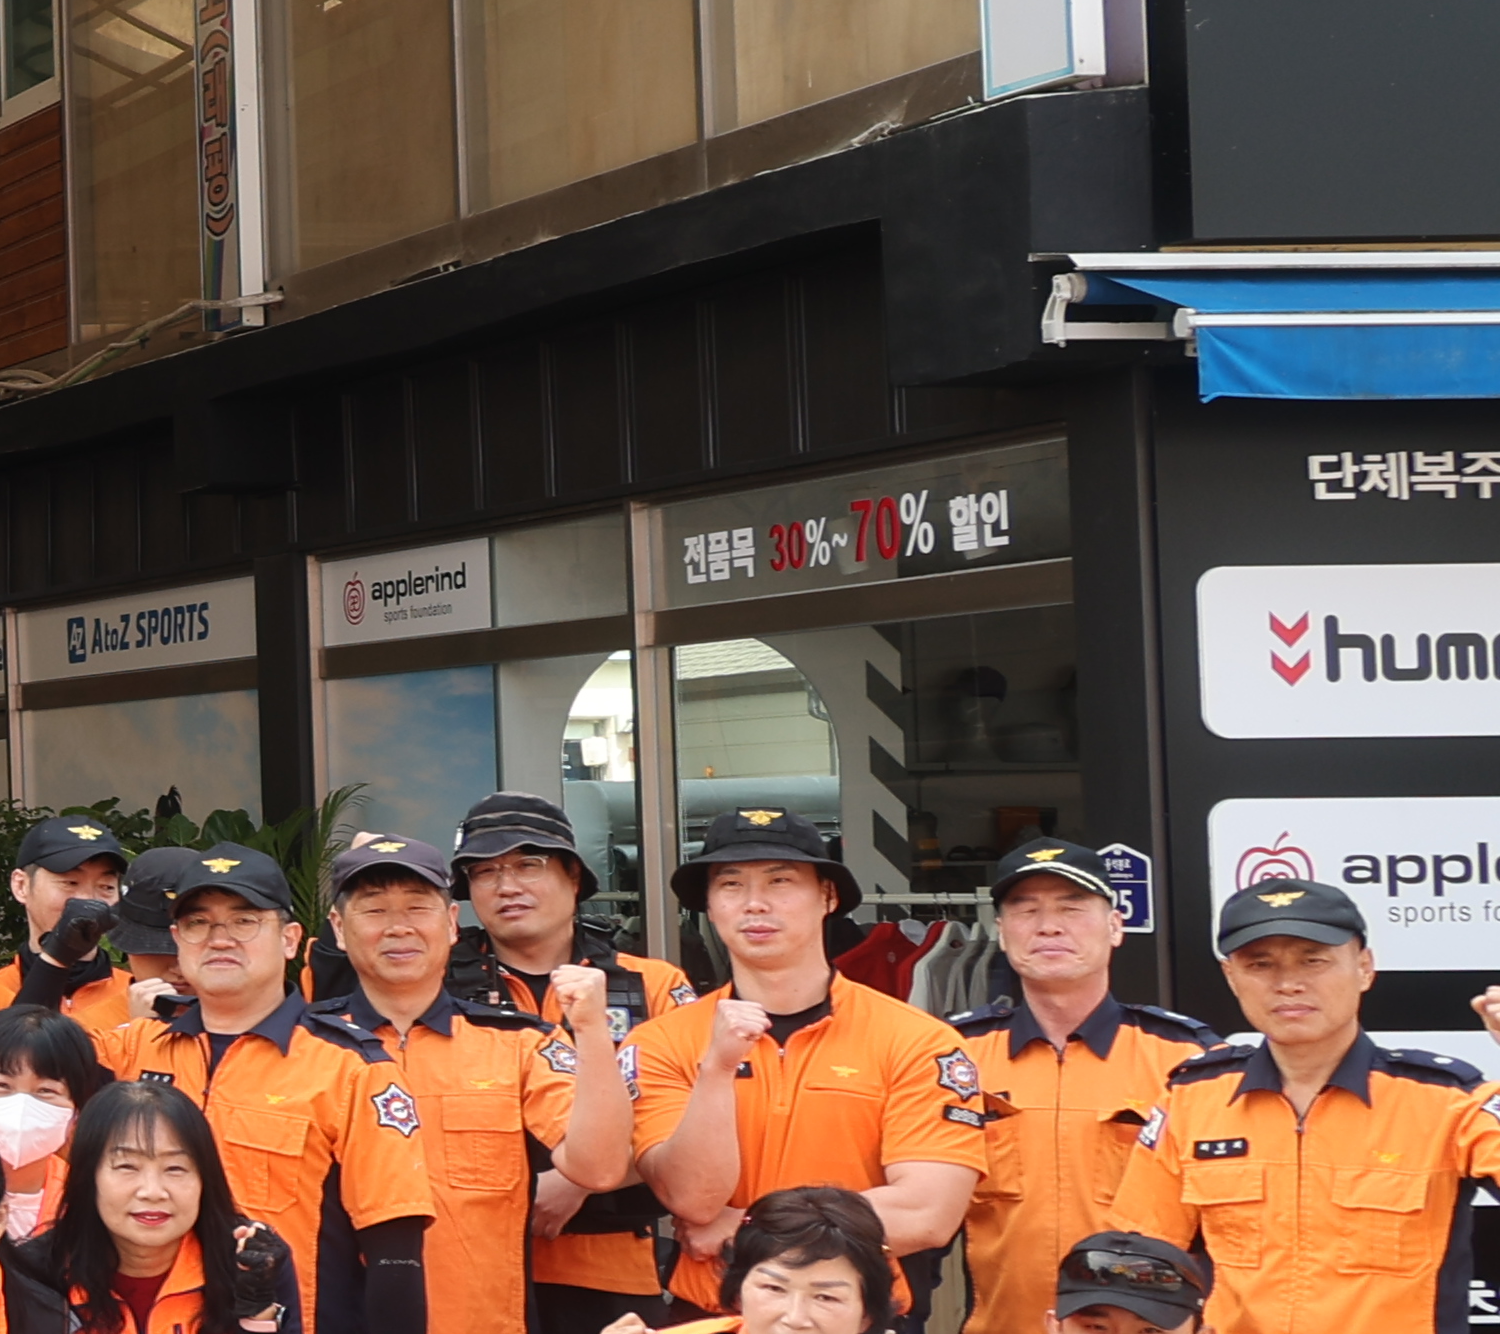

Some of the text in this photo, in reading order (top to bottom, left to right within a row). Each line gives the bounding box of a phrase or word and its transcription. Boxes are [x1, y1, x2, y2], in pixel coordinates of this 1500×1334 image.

[684, 527, 756, 584] 전품목
[949, 490, 1010, 552] 할인
[371, 562, 466, 606] applerind
[136, 601, 209, 650] SPORTS
[1324, 614, 1500, 683] hum
[1341, 842, 1500, 895] appl
[1387, 902, 1472, 928] sports
